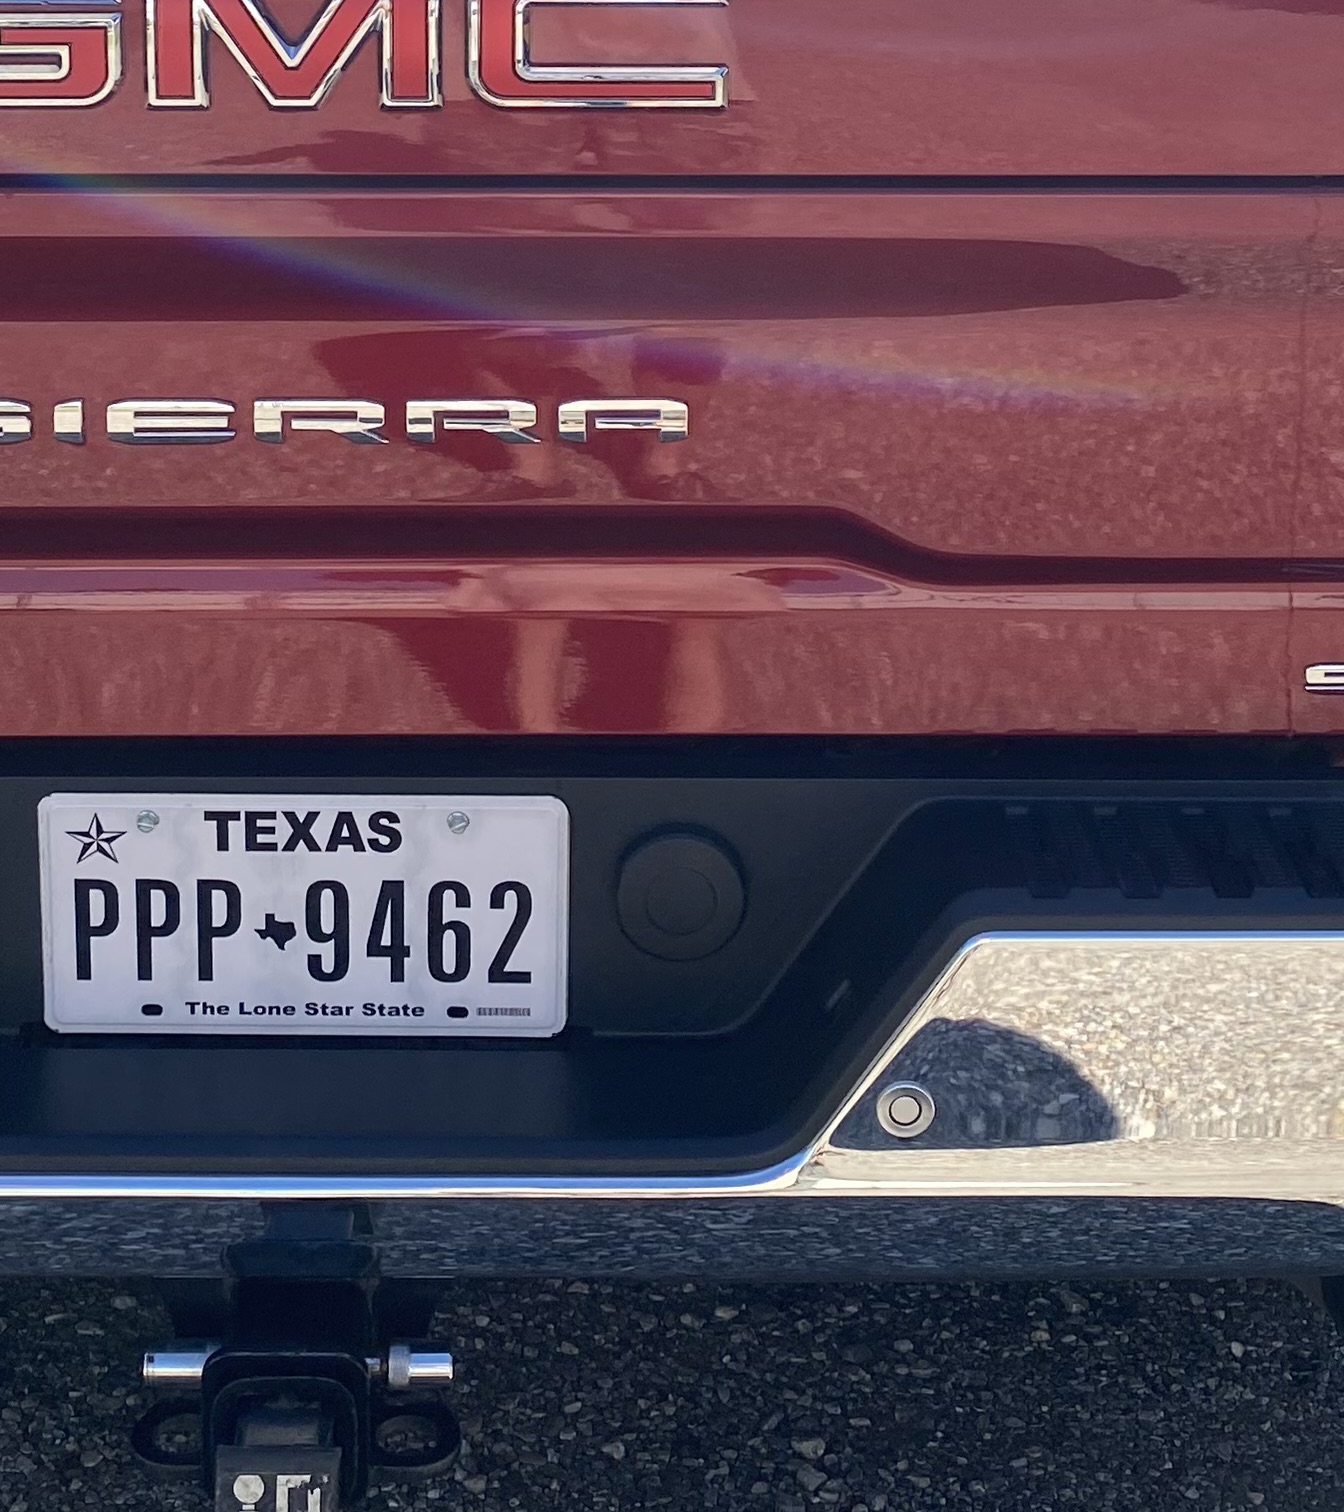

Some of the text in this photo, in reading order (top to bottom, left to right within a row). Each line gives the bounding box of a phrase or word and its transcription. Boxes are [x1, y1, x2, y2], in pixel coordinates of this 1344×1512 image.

[204, 810, 403, 853] TEXAS
[185, 1001, 425, 1017] The Lone Star State
